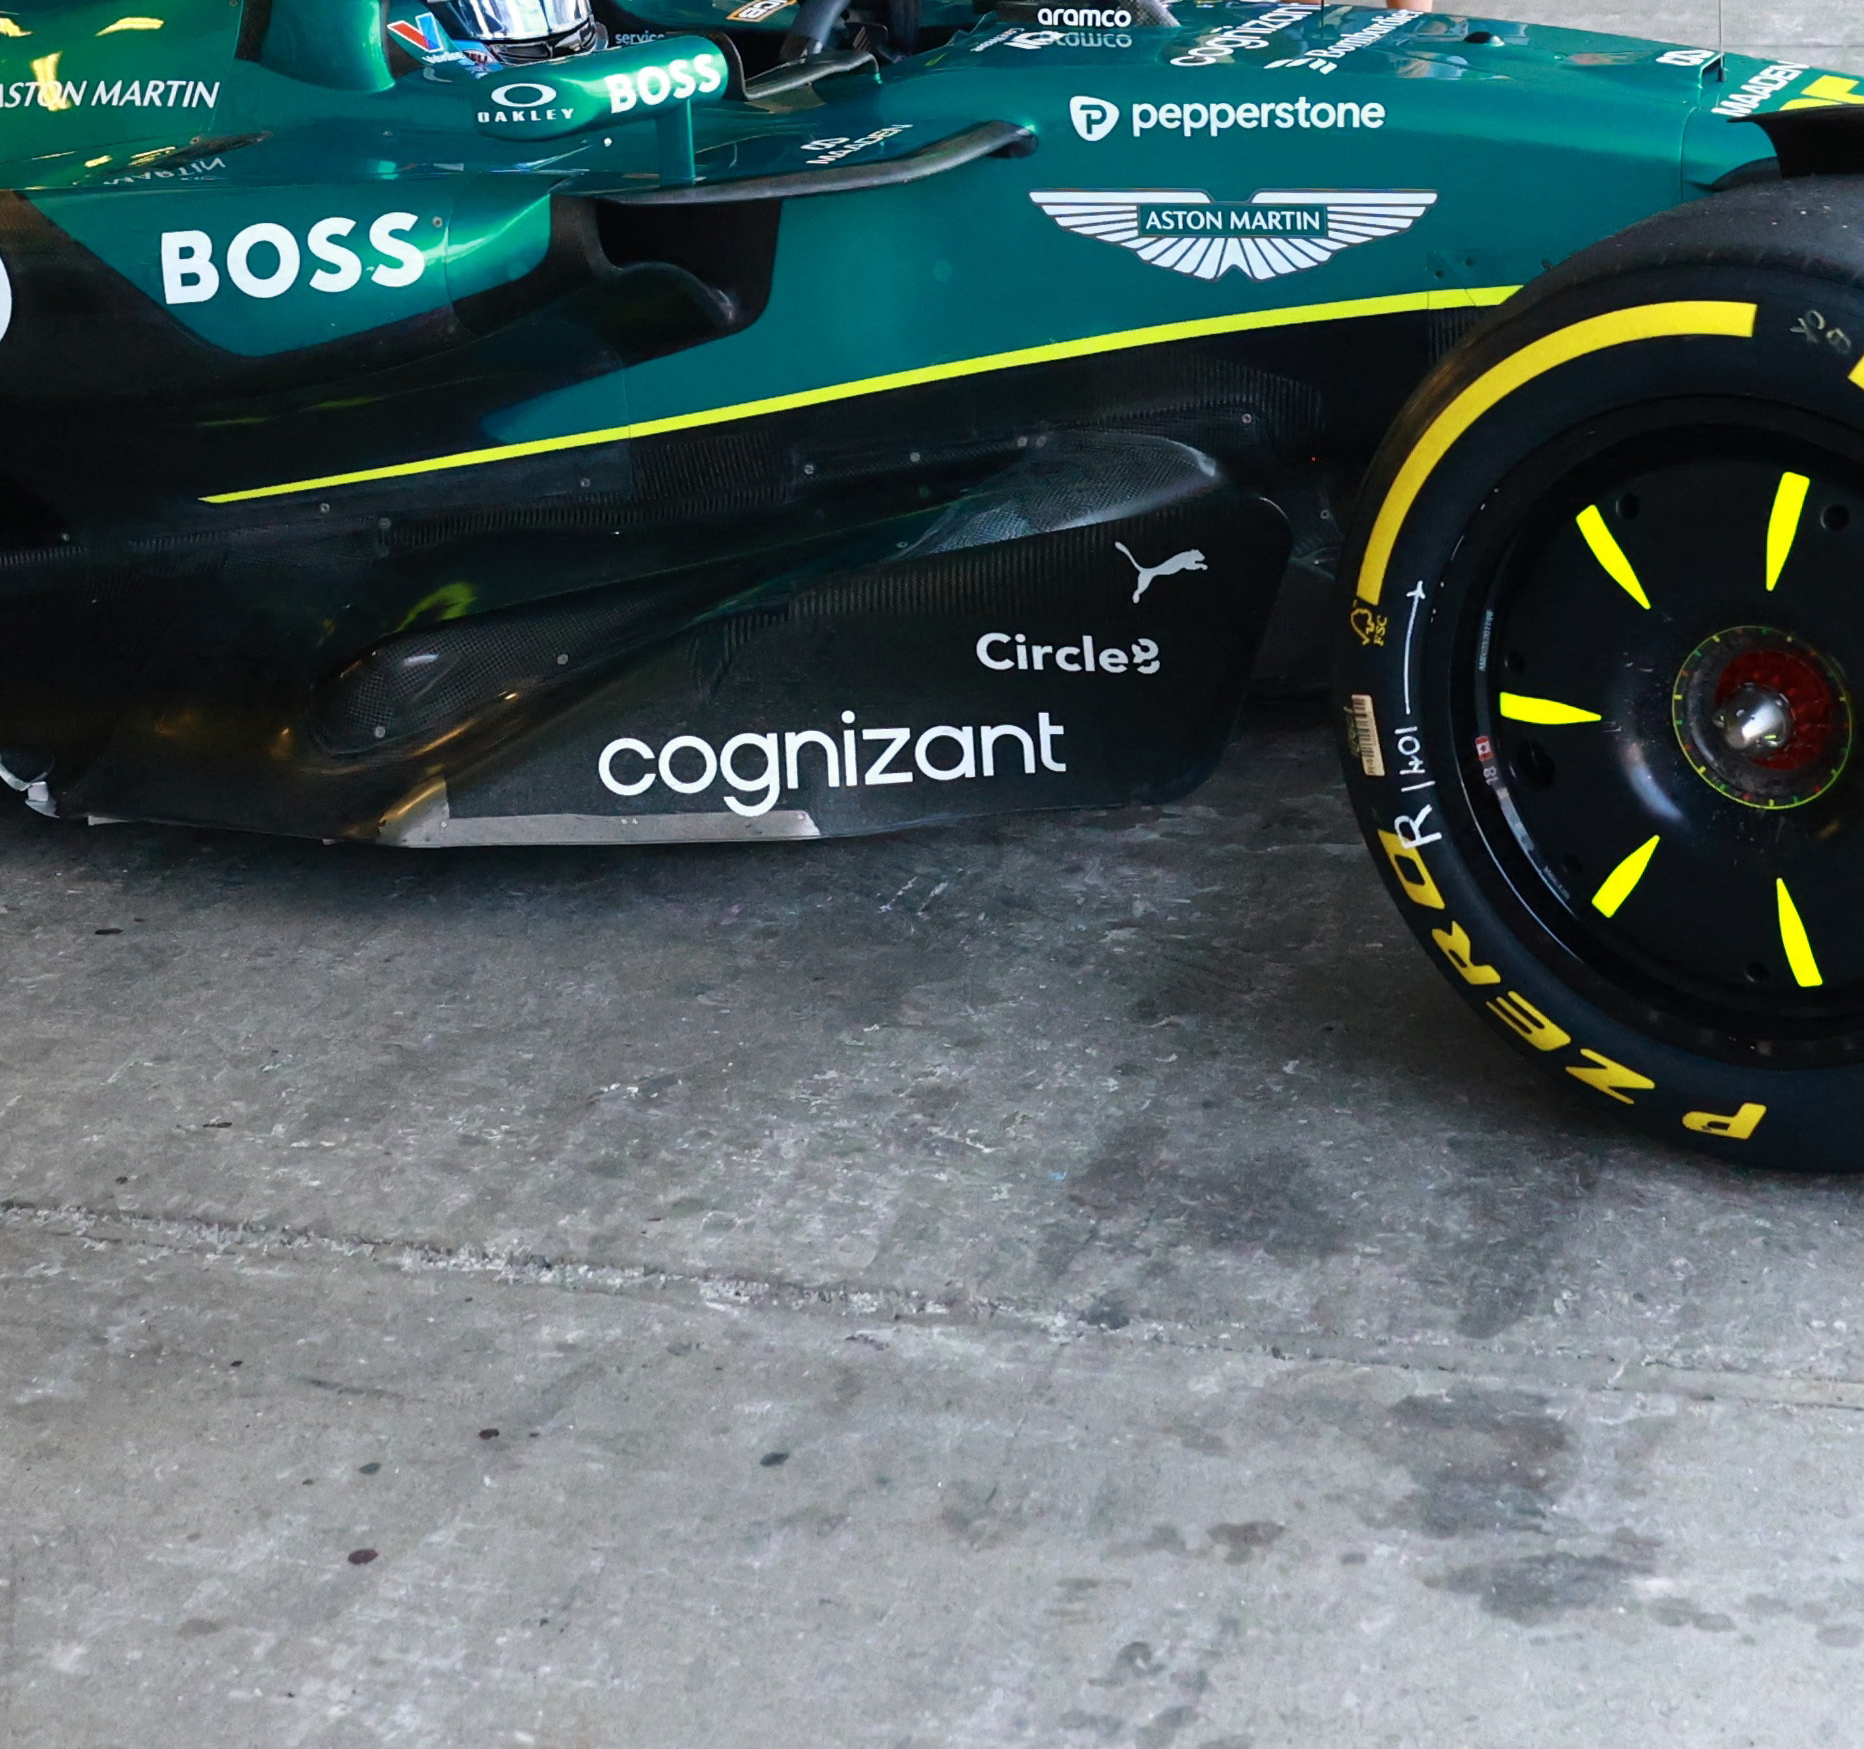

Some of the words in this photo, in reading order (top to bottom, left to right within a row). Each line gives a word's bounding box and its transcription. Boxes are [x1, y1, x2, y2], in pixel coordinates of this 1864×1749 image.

[615, 29, 665, 44] servic
[1038, 8, 1132, 28] aramco
[1170, 3, 1326, 67] cognizant
[1305, 9, 1423, 59] Bombardier
[91, 80, 221, 109] MARTIN
[604, 52, 722, 115] BOSS
[1711, 60, 1811, 117] MAADEN
[477, 106, 574, 125] OAKLEY
[1131, 96, 1386, 138] pepperstone
[1145, 209, 1225, 231] ASTON
[1229, 209, 1321, 231] MARTIN
[160, 211, 426, 305] BOSS
[1373, 616, 1388, 648] FSC
[598, 711, 1067, 818] cognizant
[1393, 803, 1443, 850] R
[1378, 829, 1656, 1105] ZERO
[1681, 1101, 1768, 1140] P
